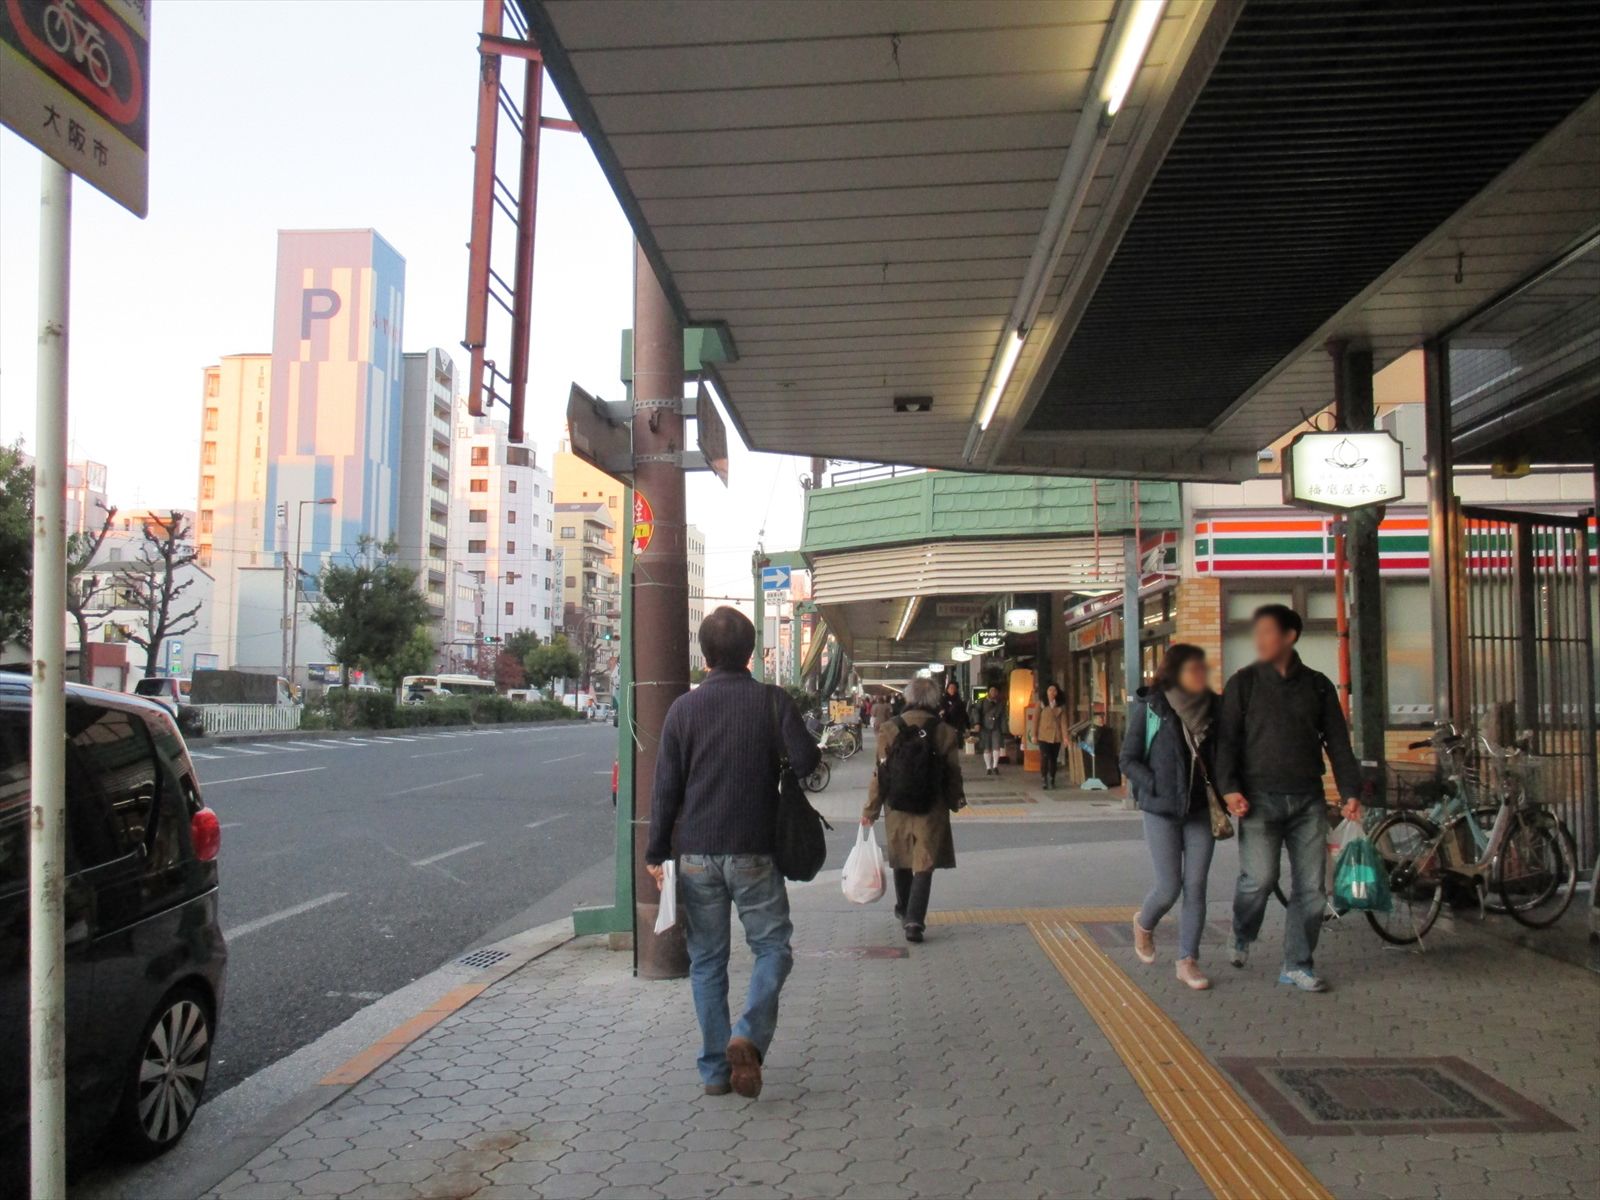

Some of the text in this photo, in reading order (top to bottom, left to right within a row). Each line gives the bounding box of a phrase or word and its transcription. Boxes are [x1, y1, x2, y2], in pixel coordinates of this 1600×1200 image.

[43, 105, 109, 166] 大阪市
[301, 288, 342, 340] P
[172, 643, 181, 654] P
